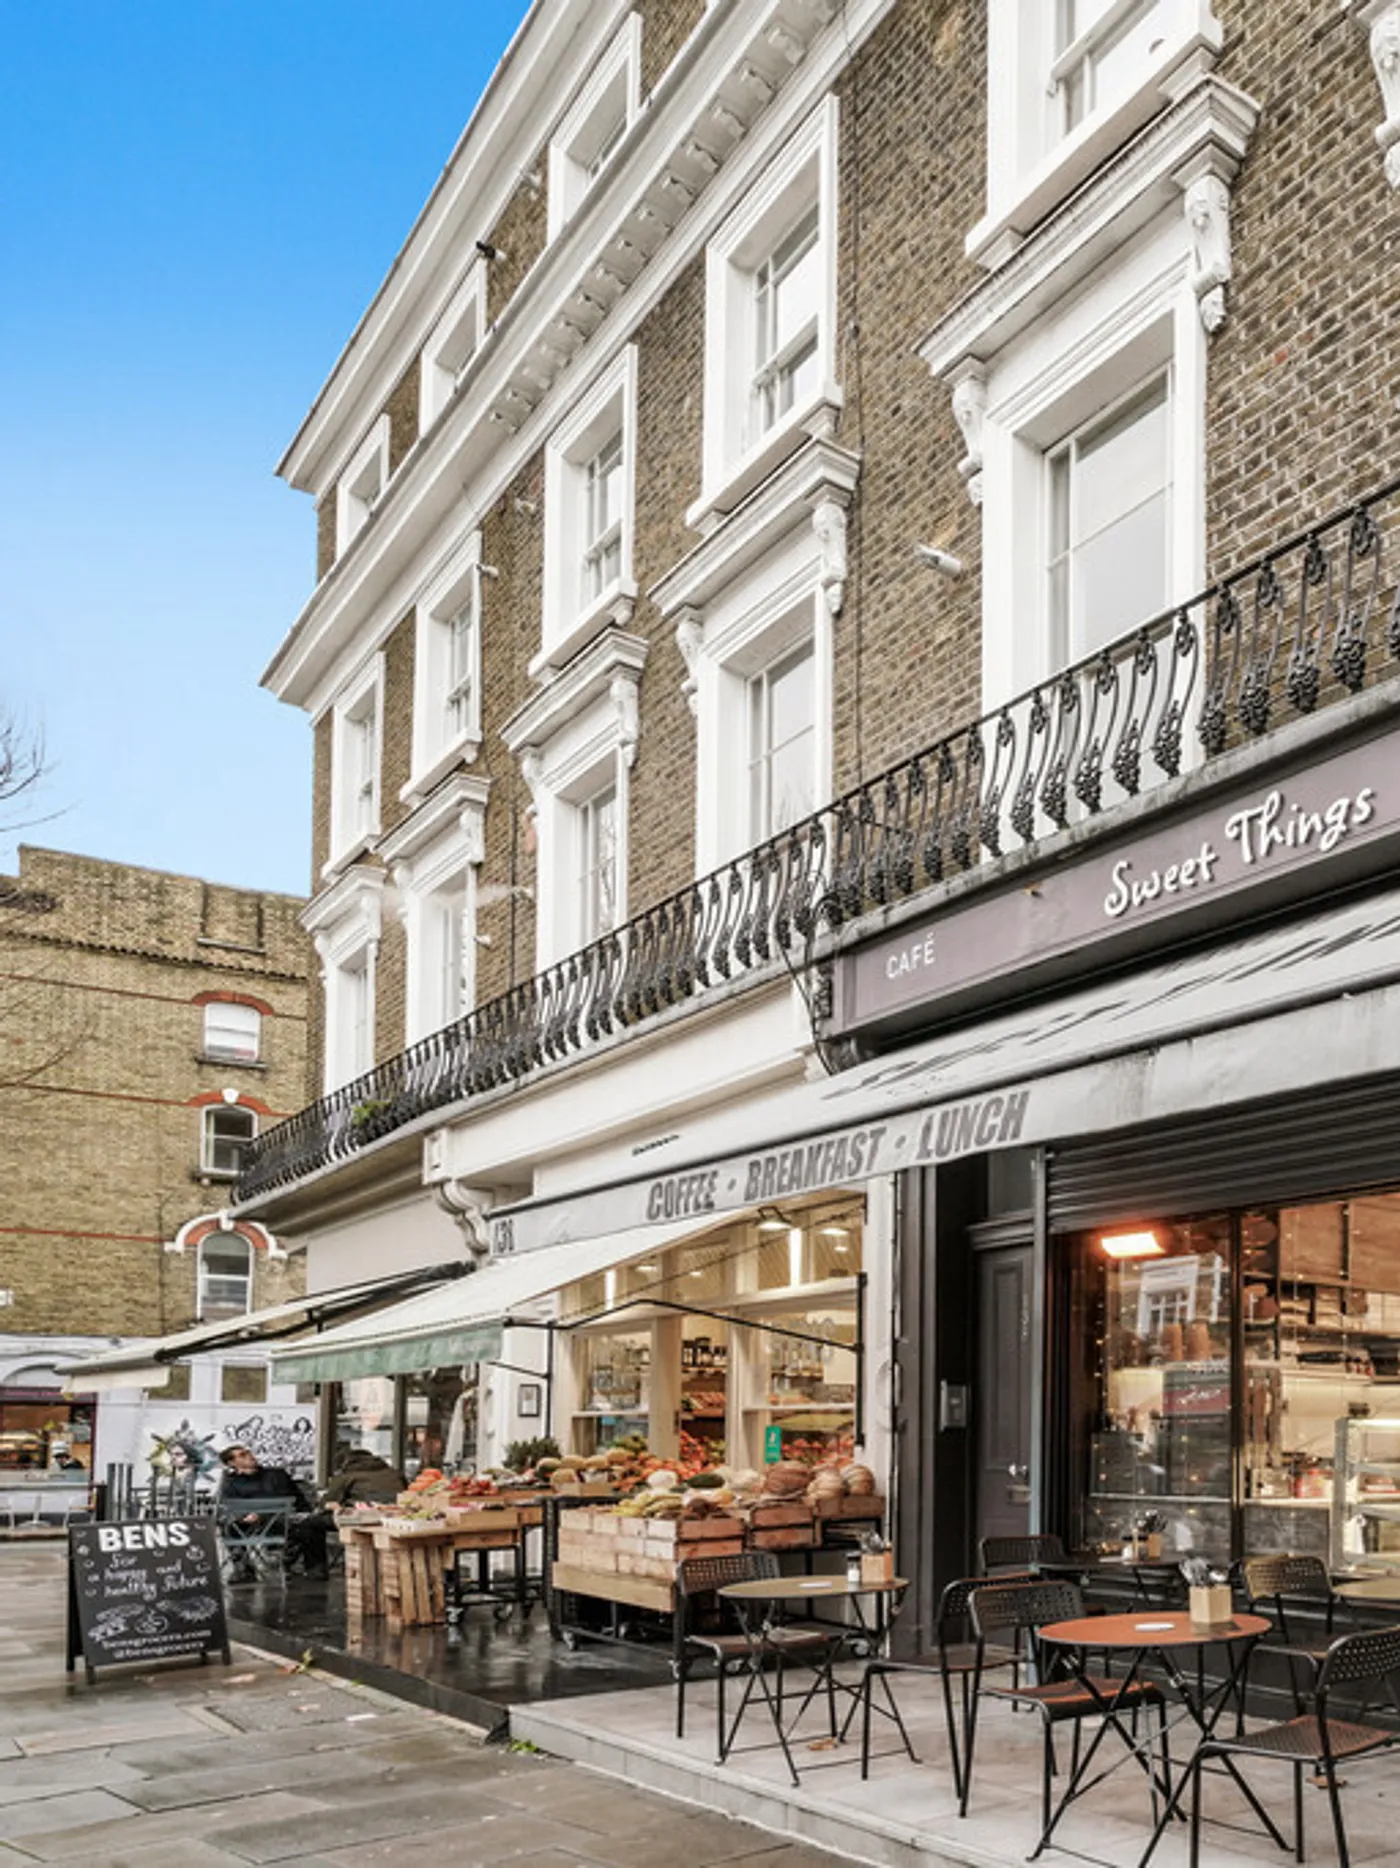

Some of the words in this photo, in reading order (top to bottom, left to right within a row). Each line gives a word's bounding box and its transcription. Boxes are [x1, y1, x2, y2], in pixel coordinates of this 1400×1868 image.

[1104, 842, 1218, 916] Sweet
[1225, 788, 1375, 863] Things
[886, 932, 936, 979] CAFÉ
[646, 1170, 718, 1220] COFFEE
[744, 1126, 887, 1201] BREAKFAST
[916, 1090, 1030, 1160] LUNCH
[98, 1522, 191, 1552] BENS
